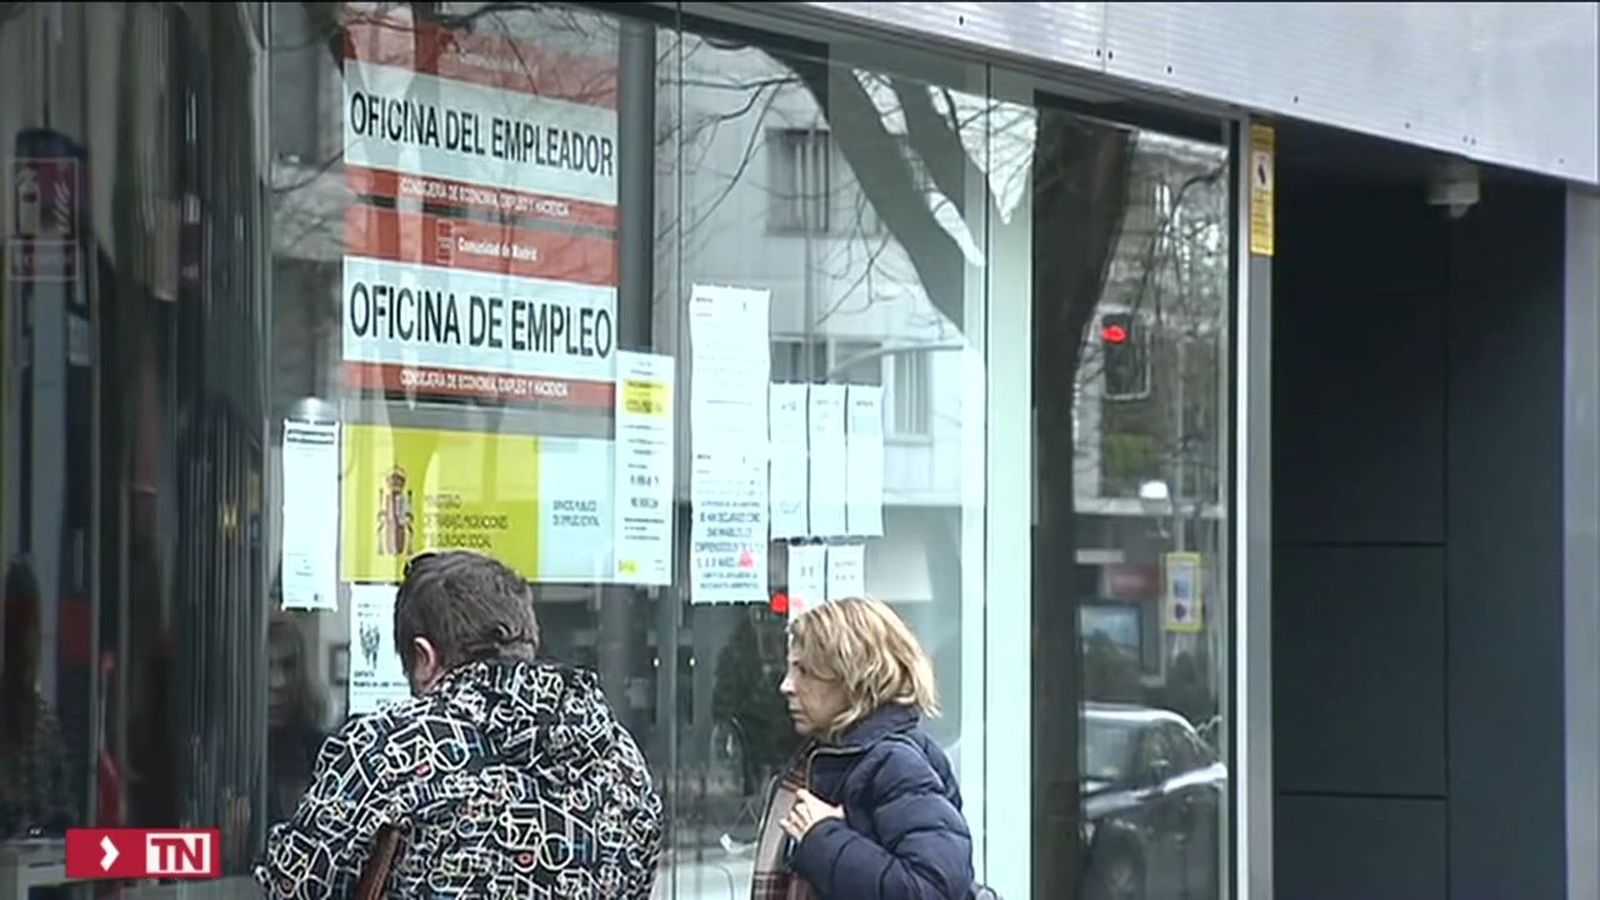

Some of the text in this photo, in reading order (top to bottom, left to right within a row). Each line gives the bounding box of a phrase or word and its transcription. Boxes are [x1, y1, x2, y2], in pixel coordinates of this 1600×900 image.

[350, 91, 614, 176] OFICINA DEL EMPLEADOR
[350, 282, 613, 359] OFICINA DE EMPLEO
